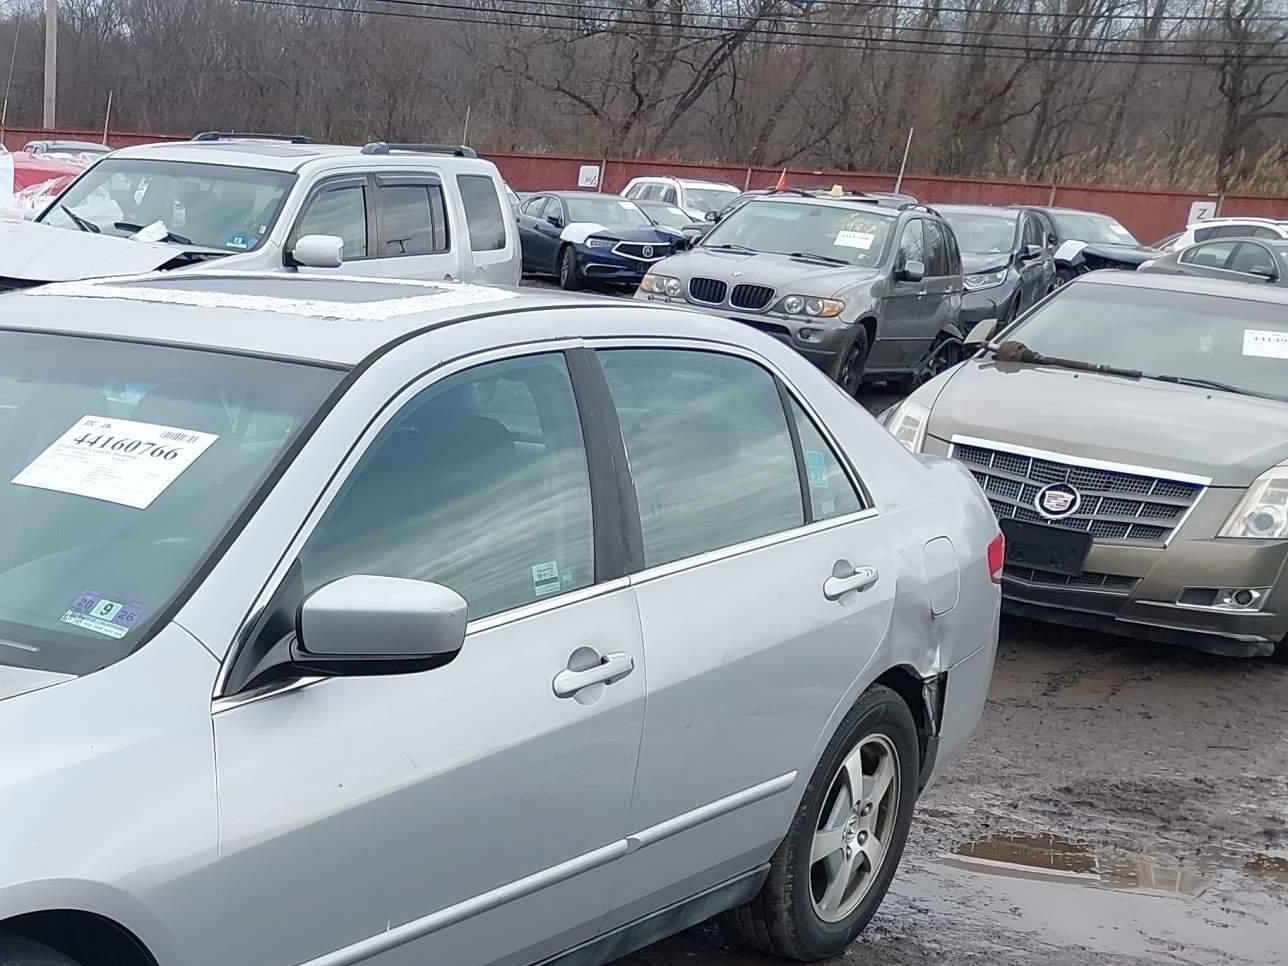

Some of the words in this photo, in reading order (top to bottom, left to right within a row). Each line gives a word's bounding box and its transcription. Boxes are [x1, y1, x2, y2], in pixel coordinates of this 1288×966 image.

[73, 432, 184, 461] 44160766
[99, 602, 114, 617] 9
[118, 610, 137, 623] 26
